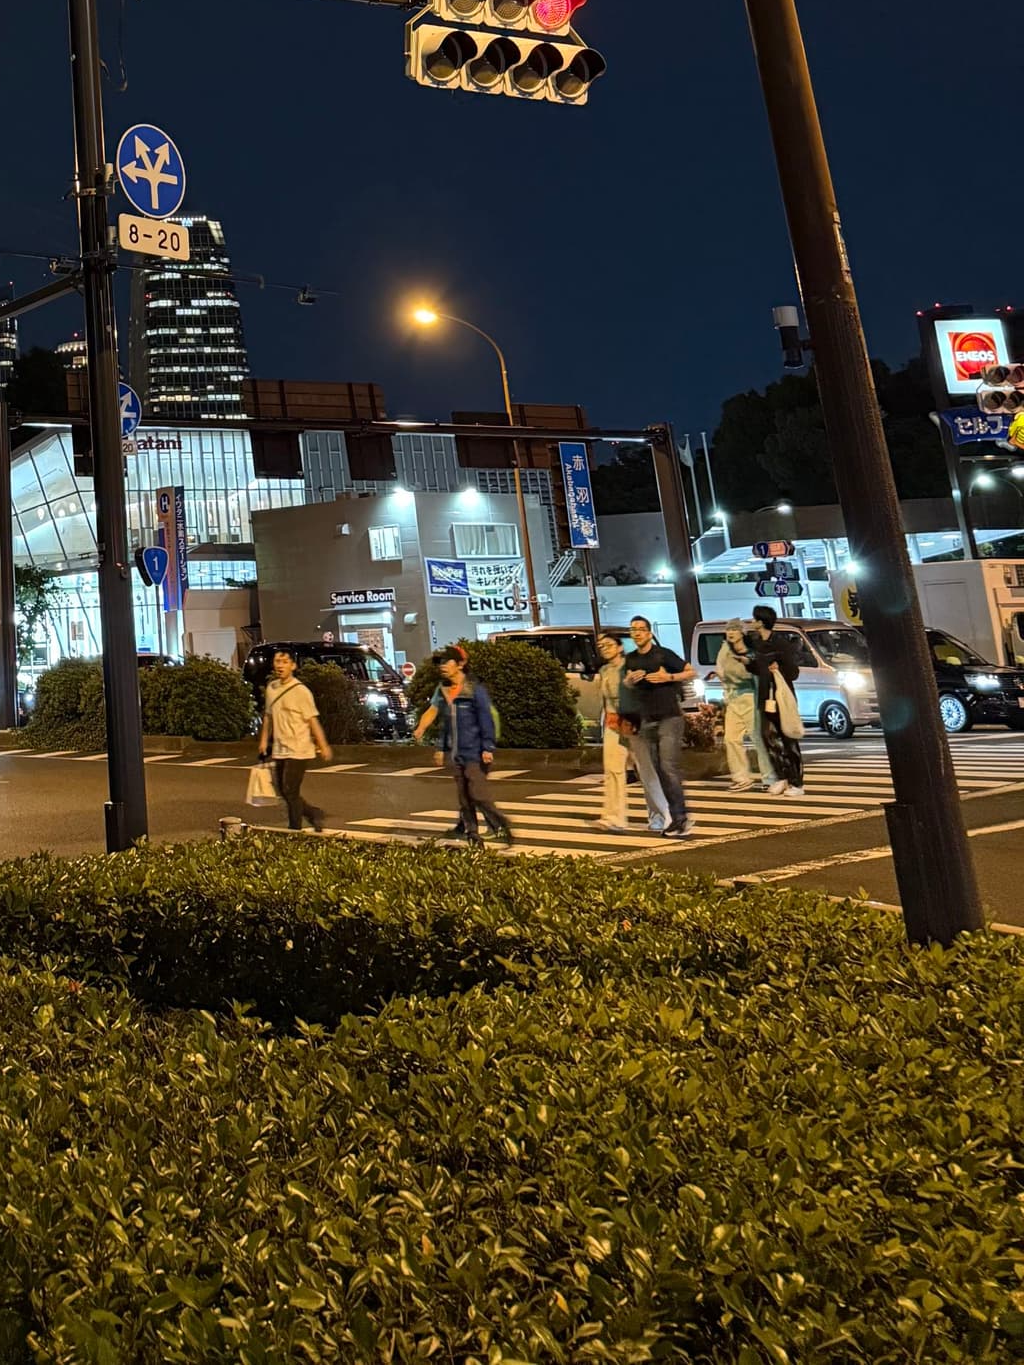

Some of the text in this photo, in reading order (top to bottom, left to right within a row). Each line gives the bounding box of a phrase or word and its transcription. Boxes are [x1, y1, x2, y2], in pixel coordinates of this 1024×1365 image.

[129, 223, 180, 252] 8-20
[955, 350, 995, 362] ENEOS
[136, 436, 182, 451] atani
[153, 555, 159, 571] 1
[775, 583, 788, 594] 319
[331, 590, 394, 604] Service Room
